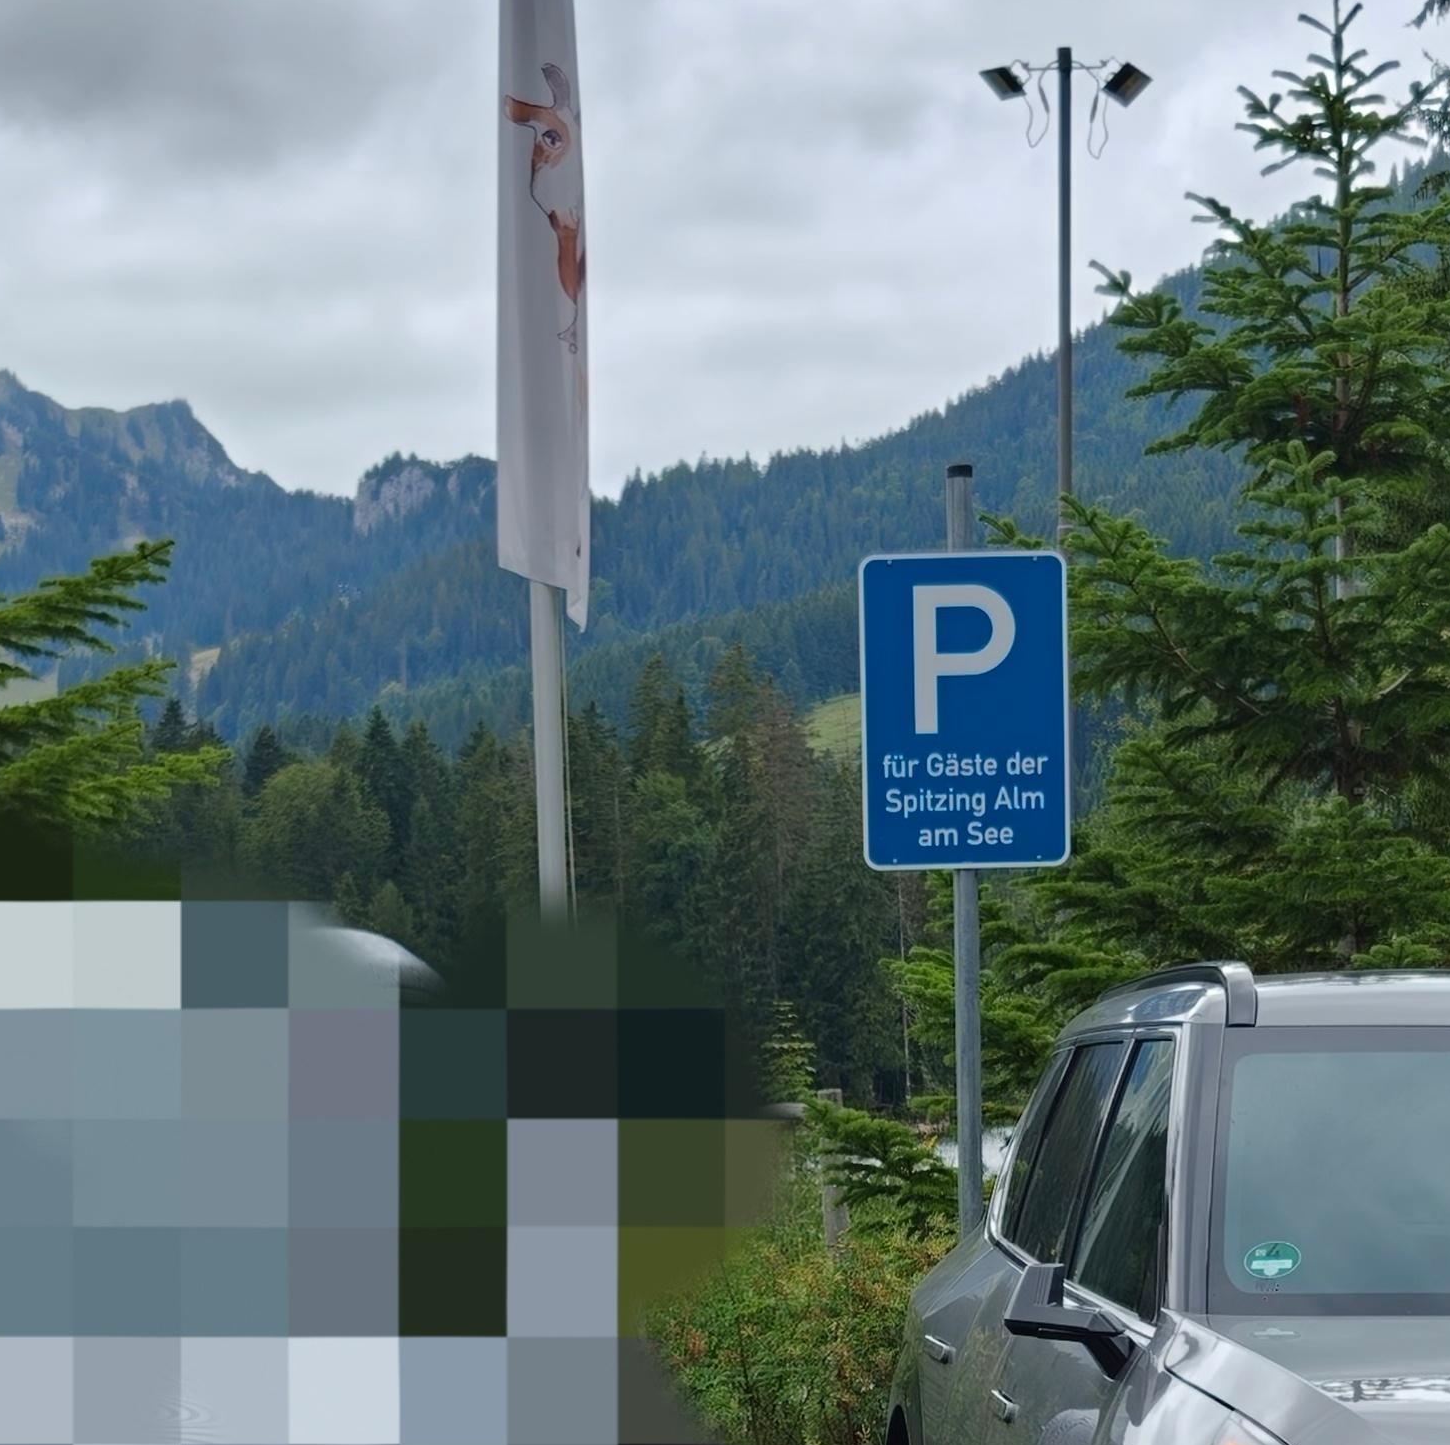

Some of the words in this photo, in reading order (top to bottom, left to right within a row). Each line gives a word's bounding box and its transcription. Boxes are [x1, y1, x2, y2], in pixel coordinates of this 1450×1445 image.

[913, 584, 1016, 734] P
[883, 755, 918, 778] für
[927, 752, 997, 777] Gäste
[1006, 751, 1048, 775] der
[885, 788, 986, 818] Spitzing
[994, 786, 1044, 810] Alm
[918, 826, 958, 846] am
[967, 822, 1014, 845] See
